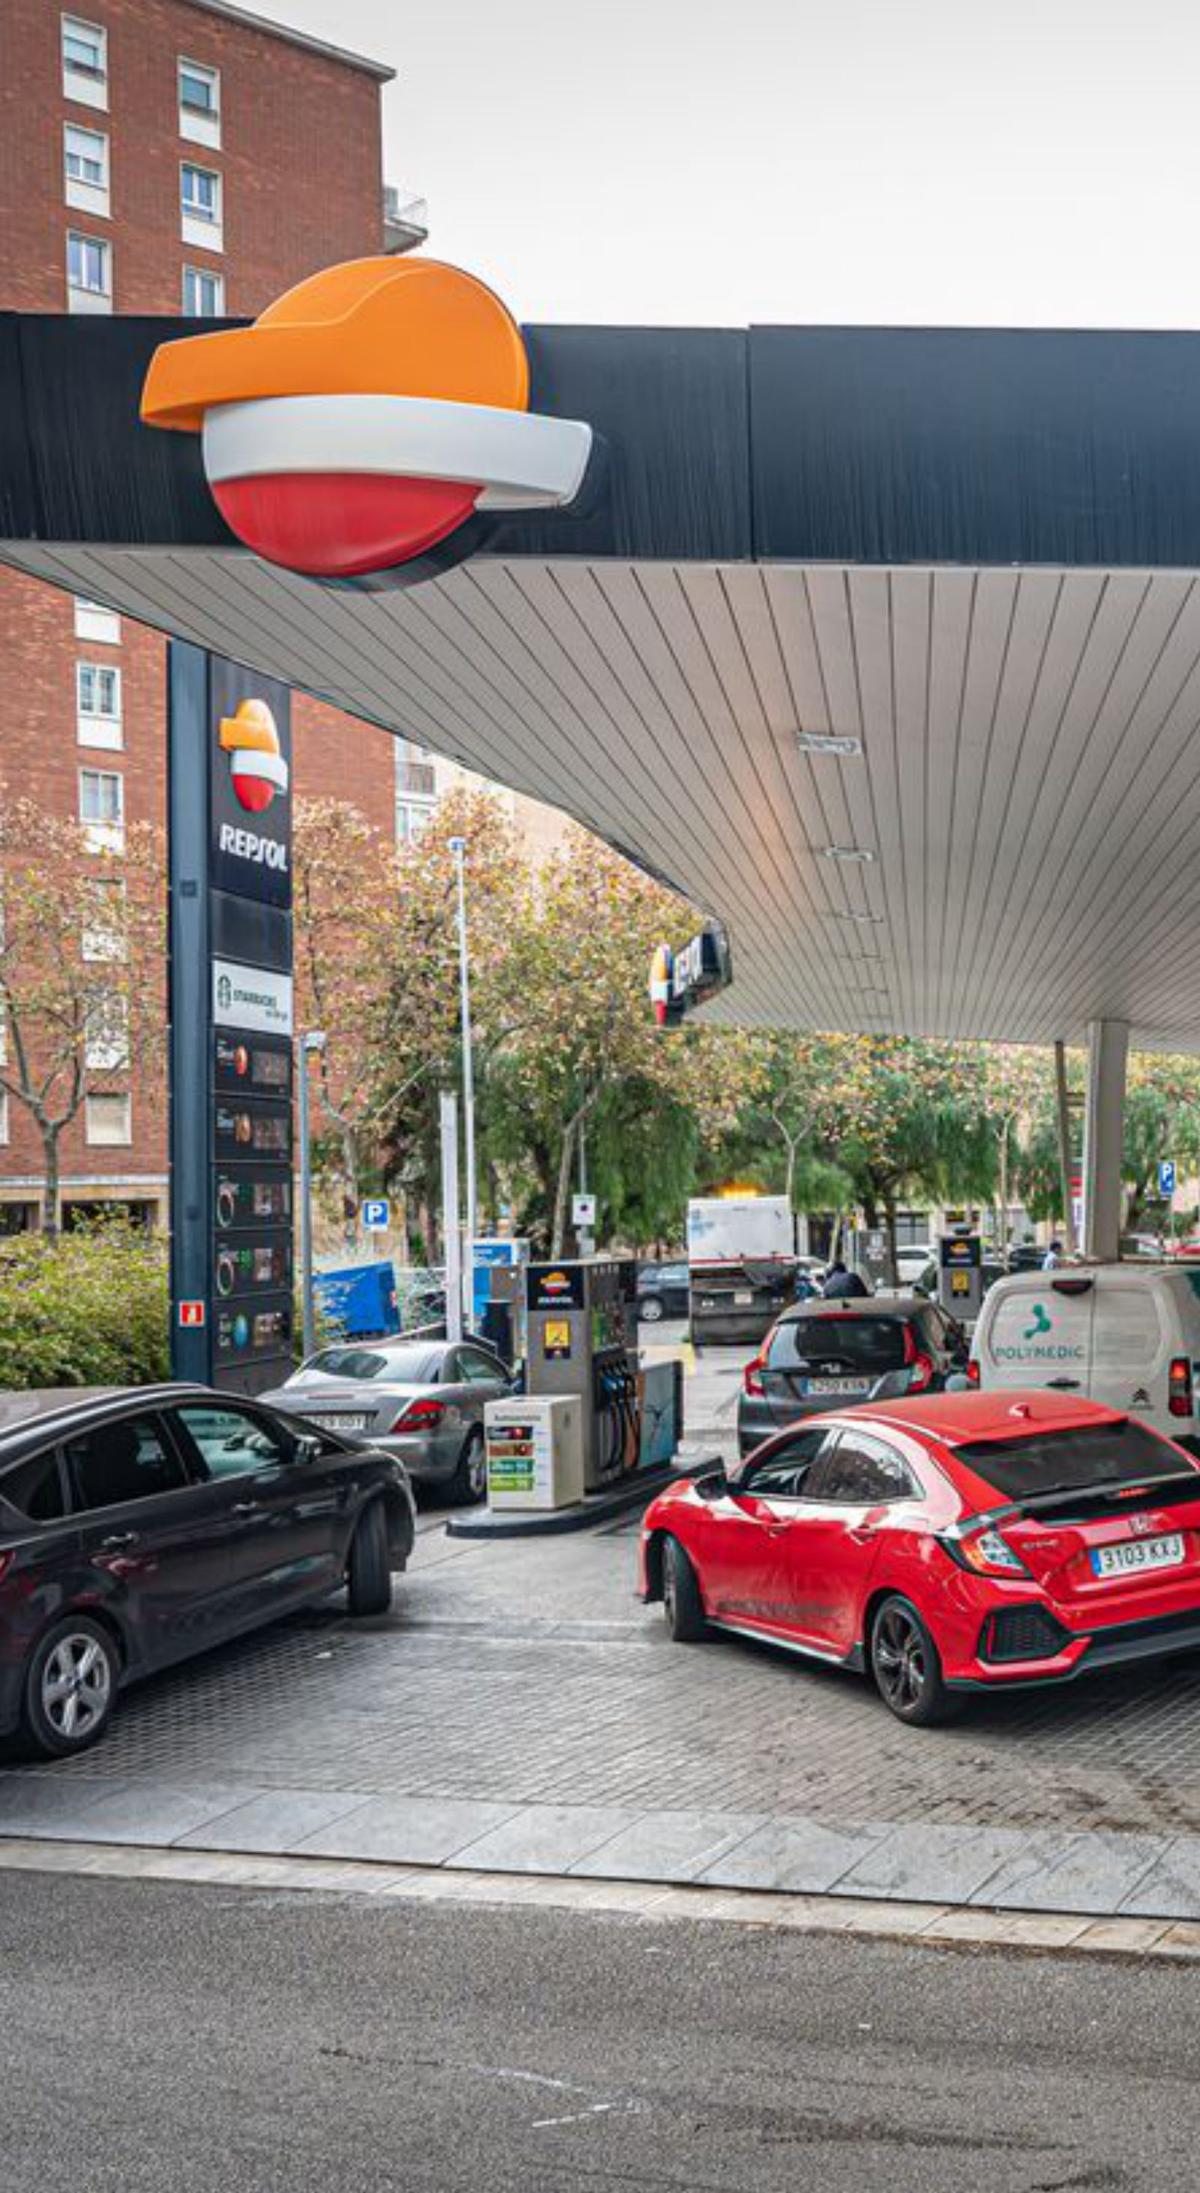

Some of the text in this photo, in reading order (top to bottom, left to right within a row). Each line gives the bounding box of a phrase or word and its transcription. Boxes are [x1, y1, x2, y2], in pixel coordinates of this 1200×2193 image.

[220, 823, 288, 872] REPSOL
[367, 1204, 383, 1223] P
[996, 1345, 1085, 1360] POLYMEDIC
[1103, 1537, 1180, 1569] 3103 KXJ
